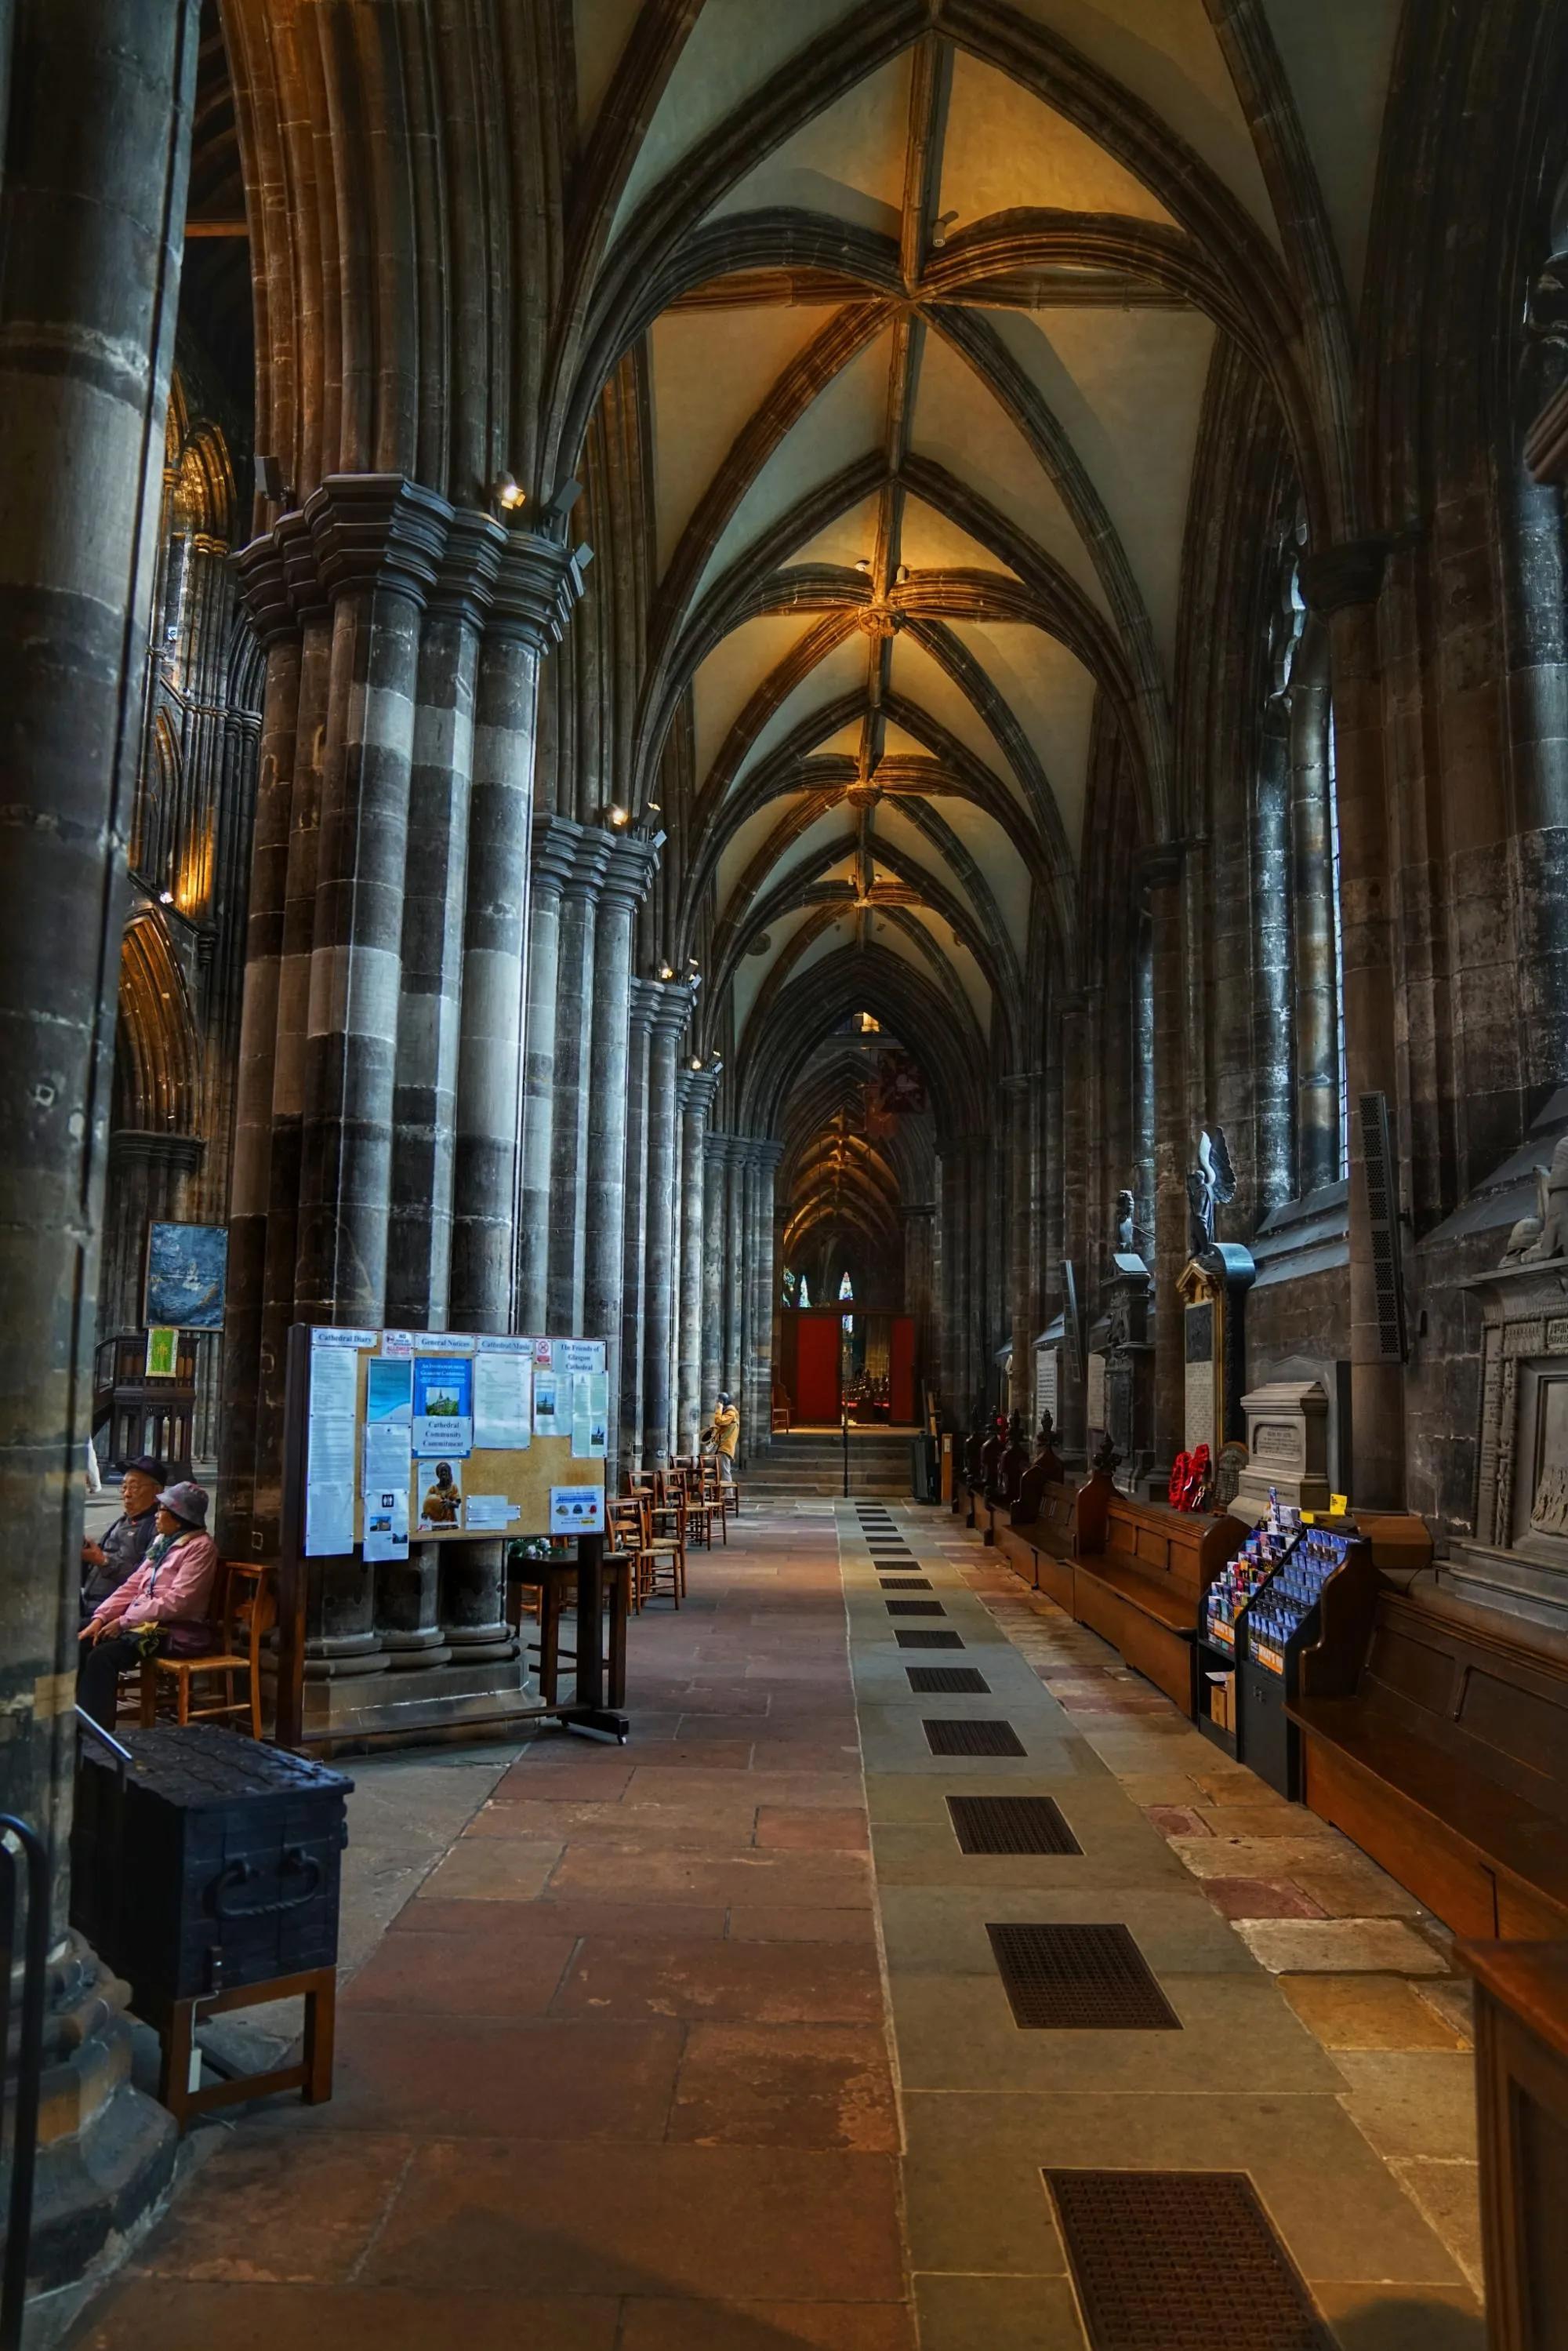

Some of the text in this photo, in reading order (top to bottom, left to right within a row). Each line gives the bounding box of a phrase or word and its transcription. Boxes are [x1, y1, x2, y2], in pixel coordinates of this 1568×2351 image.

[318, 1333, 372, 1343] Cathedral Diary
[422, 1338, 447, 1346] General
